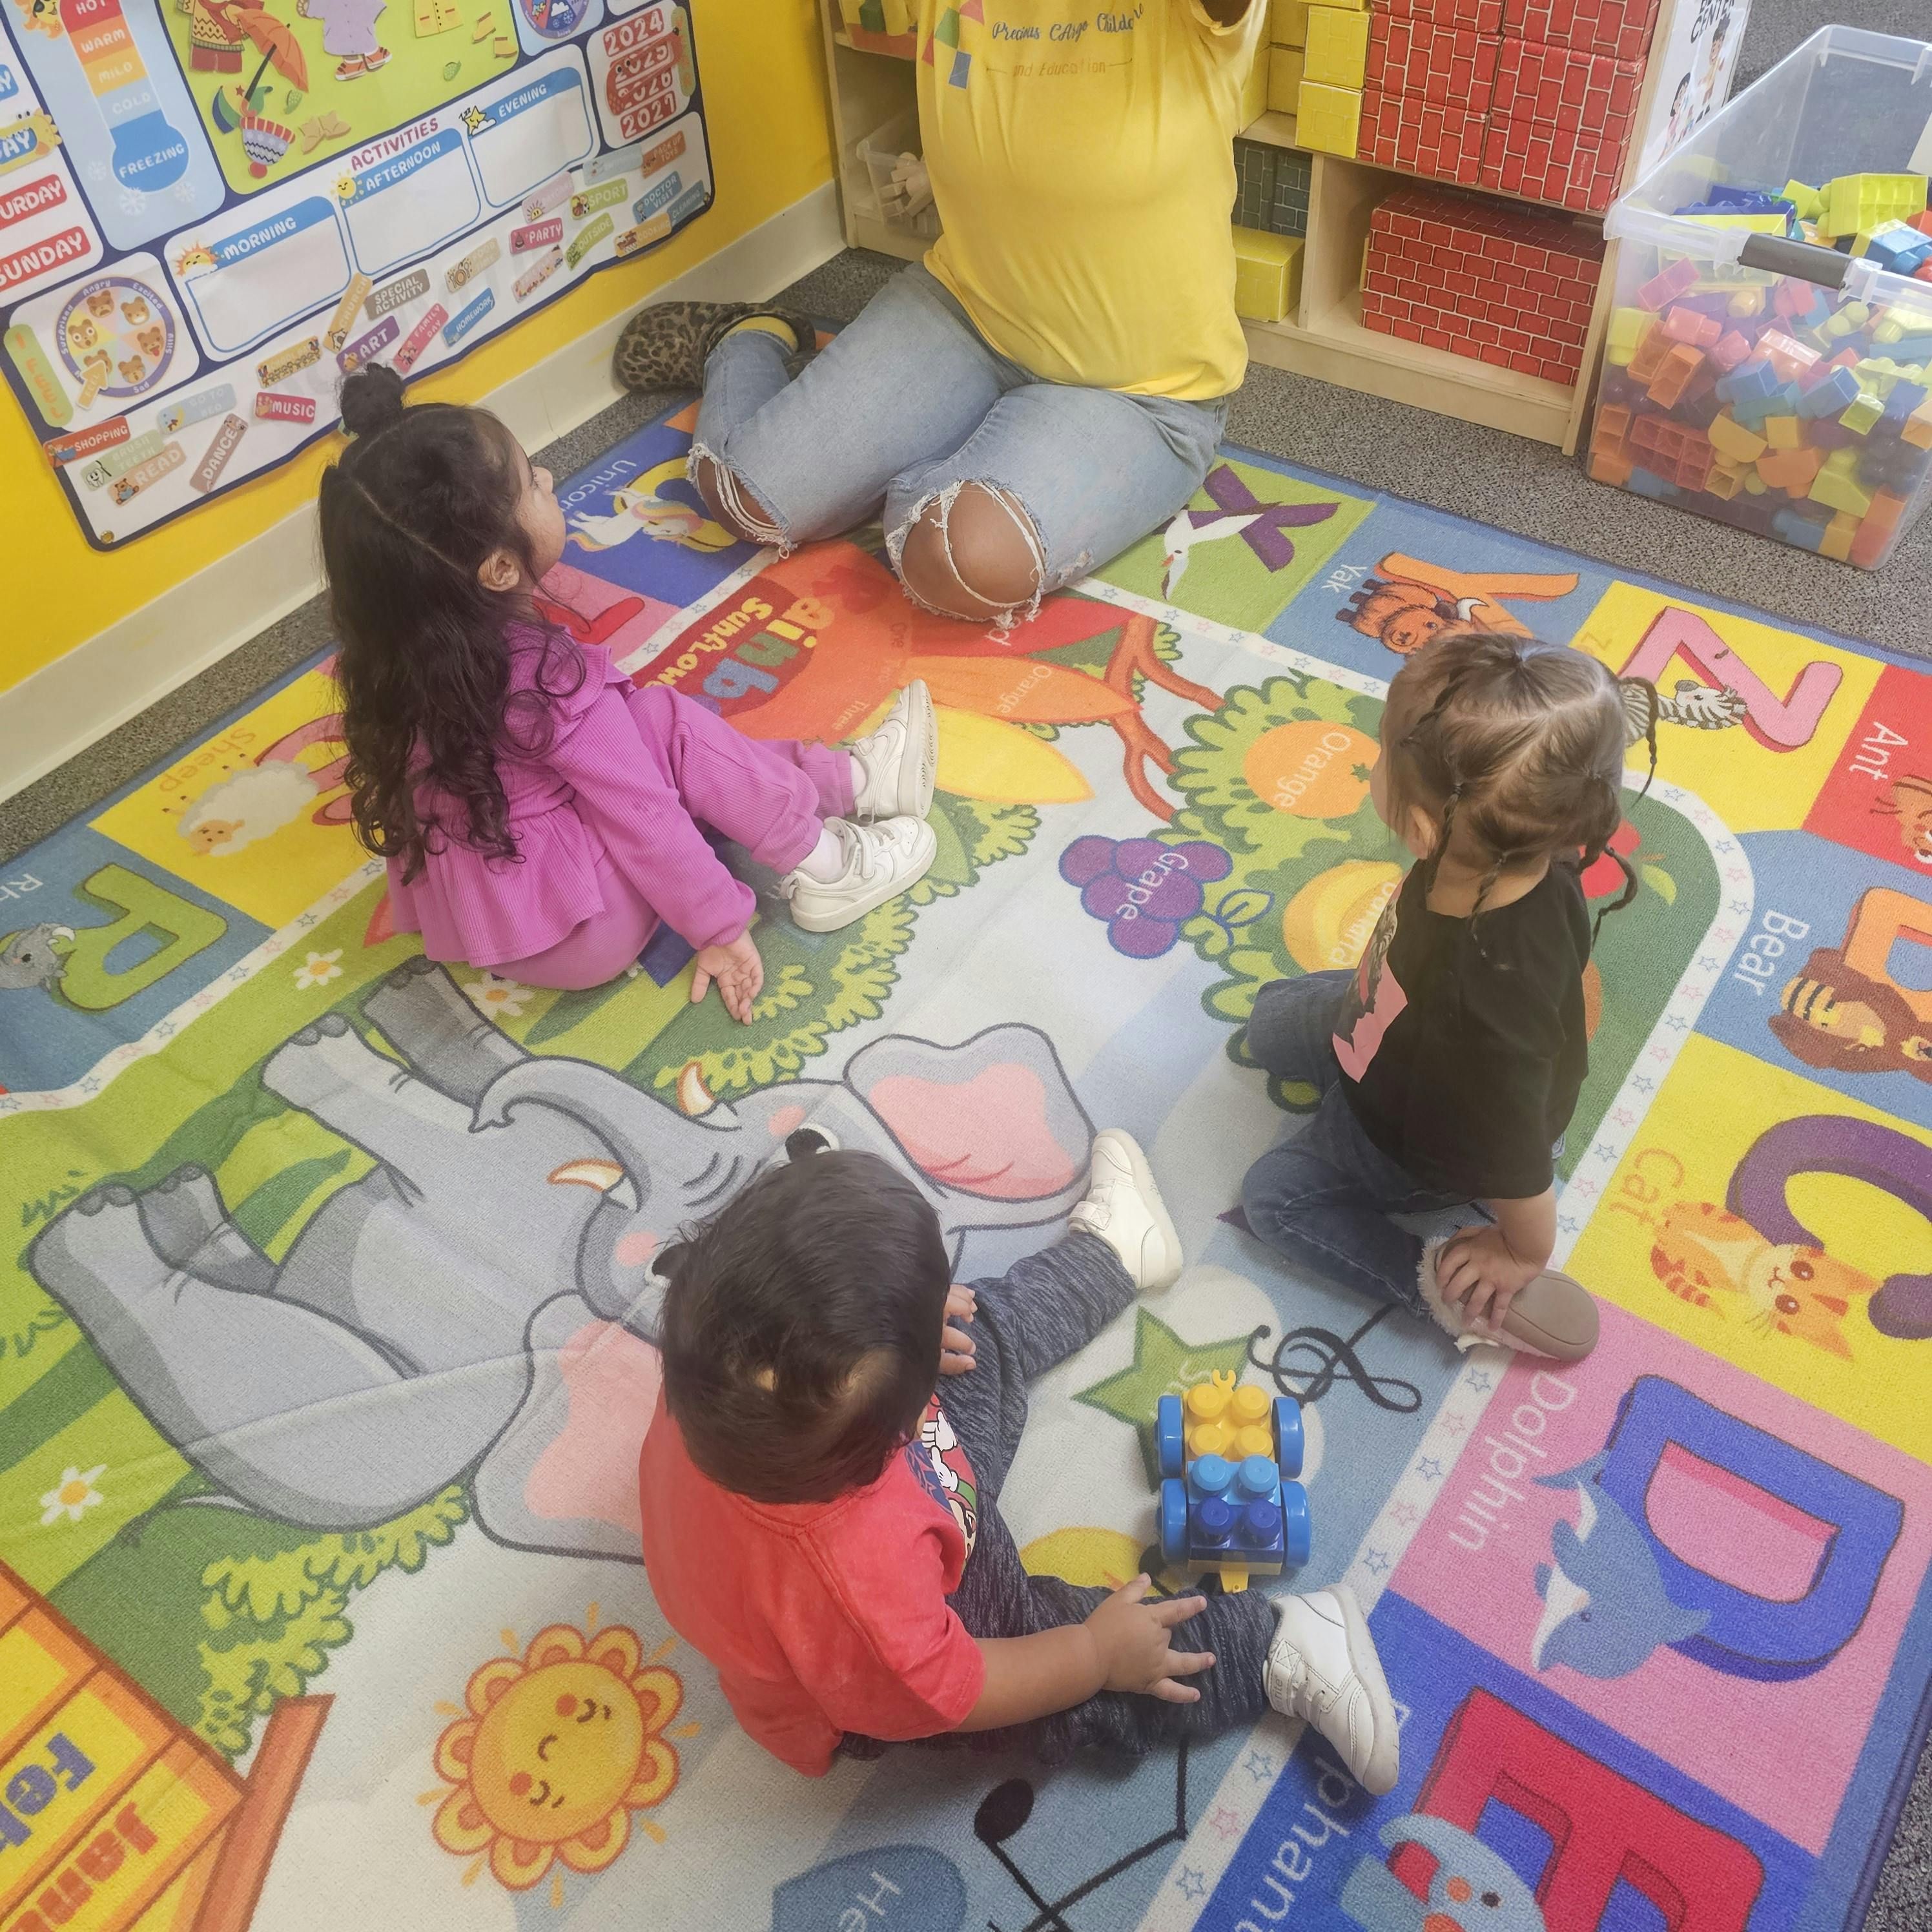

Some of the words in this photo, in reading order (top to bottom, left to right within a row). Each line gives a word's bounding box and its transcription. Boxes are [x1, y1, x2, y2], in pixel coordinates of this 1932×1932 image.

[80, 28, 126, 53] WARM
[605, 10, 663, 56] 2024
[992, 21, 1040, 41] Precious
[98, 61, 133, 83] MILD
[112, 92, 151, 114] COLD
[498, 84, 548, 118] EVENING
[622, 95, 676, 137] 2027
[351, 118, 440, 170] ACTIVITIES
[119, 143, 185, 179] FREEZING
[366, 141, 440, 190] AFTERNOON
[588, 185, 628, 207] SPORT
[644, 175, 677, 205] DOCTOR
[653, 189, 675, 209] VISIT
[223, 217, 296, 260] MORNING
[529, 223, 562, 243] PARTY
[579, 219, 612, 249] OUTSIDE
[82, 280, 110, 296] Angry
[375, 276, 420, 305] SPECIAL
[376, 284, 424, 315] ACTIVITY
[414, 305, 440, 338] FAMILY
[427, 320, 442, 338] DAY
[456, 296, 493, 333] HOMEWORK
[358, 328, 387, 358] ART
[134, 381, 150, 394] Sad
[272, 400, 315, 417] MUSIC
[74, 424, 128, 452] SHOPPING
[112, 436, 150, 462] BRUSH
[201, 426, 238, 481] DANCE
[119, 448, 156, 471] TEETH
[134, 448, 181, 486] READ
[1321, 562, 1368, 593] Yak
[996, 664, 1052, 714] Orange
[1616, 606, 1844, 753] Z
[159, 726, 257, 794] Sheep
[1849, 721, 1909, 781] Ant
[1275, 730, 1351, 808] Orange
[1116, 851, 1189, 921] Grape
[1733, 909, 1810, 996] Bear
[1609, 1148, 1685, 1225] Cat
[1446, 1369, 1578, 1550] Dolphin
[1595, 1374, 1905, 1683] D
